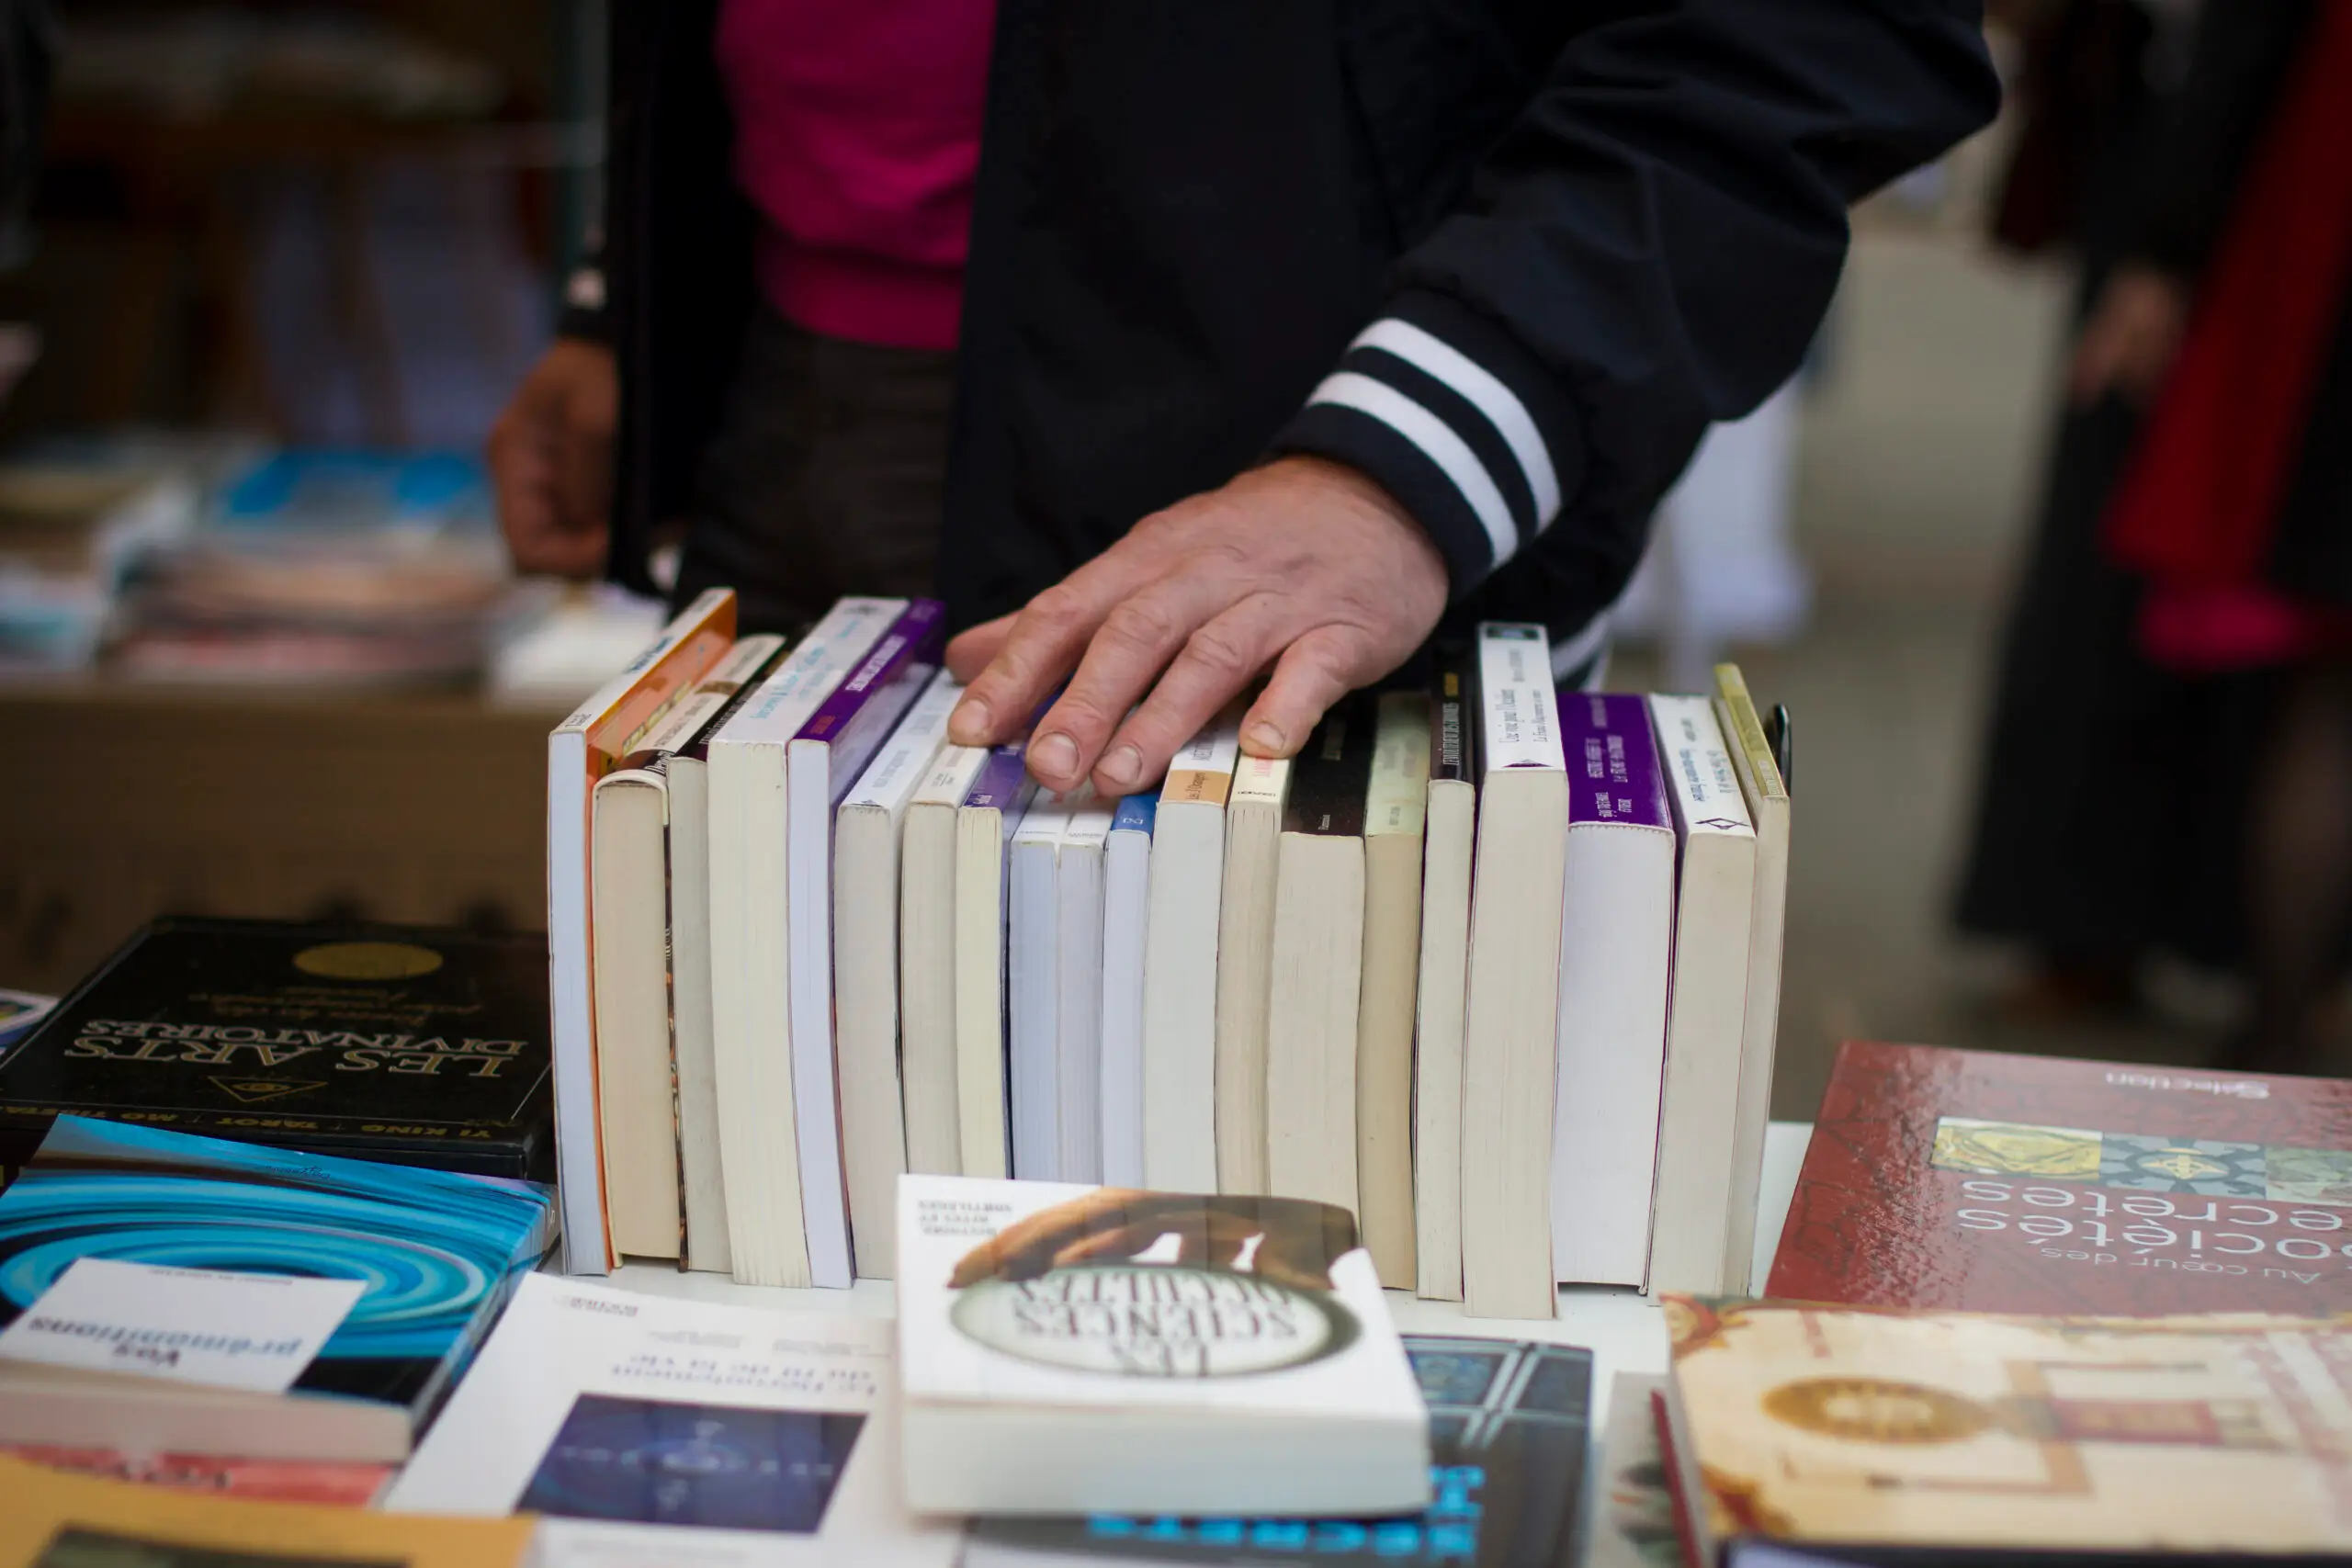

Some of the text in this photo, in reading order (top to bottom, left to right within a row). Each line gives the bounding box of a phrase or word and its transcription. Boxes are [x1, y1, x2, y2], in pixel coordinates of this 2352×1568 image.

[63, 1035, 514, 1077] LES ARTS
[79, 1020, 527, 1056] DIVINATOIRES
[213, 1116, 320, 1130] TAROT
[360, 1122, 447, 1136] KING
[1956, 1208, 2352, 1265] ociétés
[2040, 1246, 2321, 1286] Au cœur des
[1012, 1298, 1297, 1341] SCIENCES
